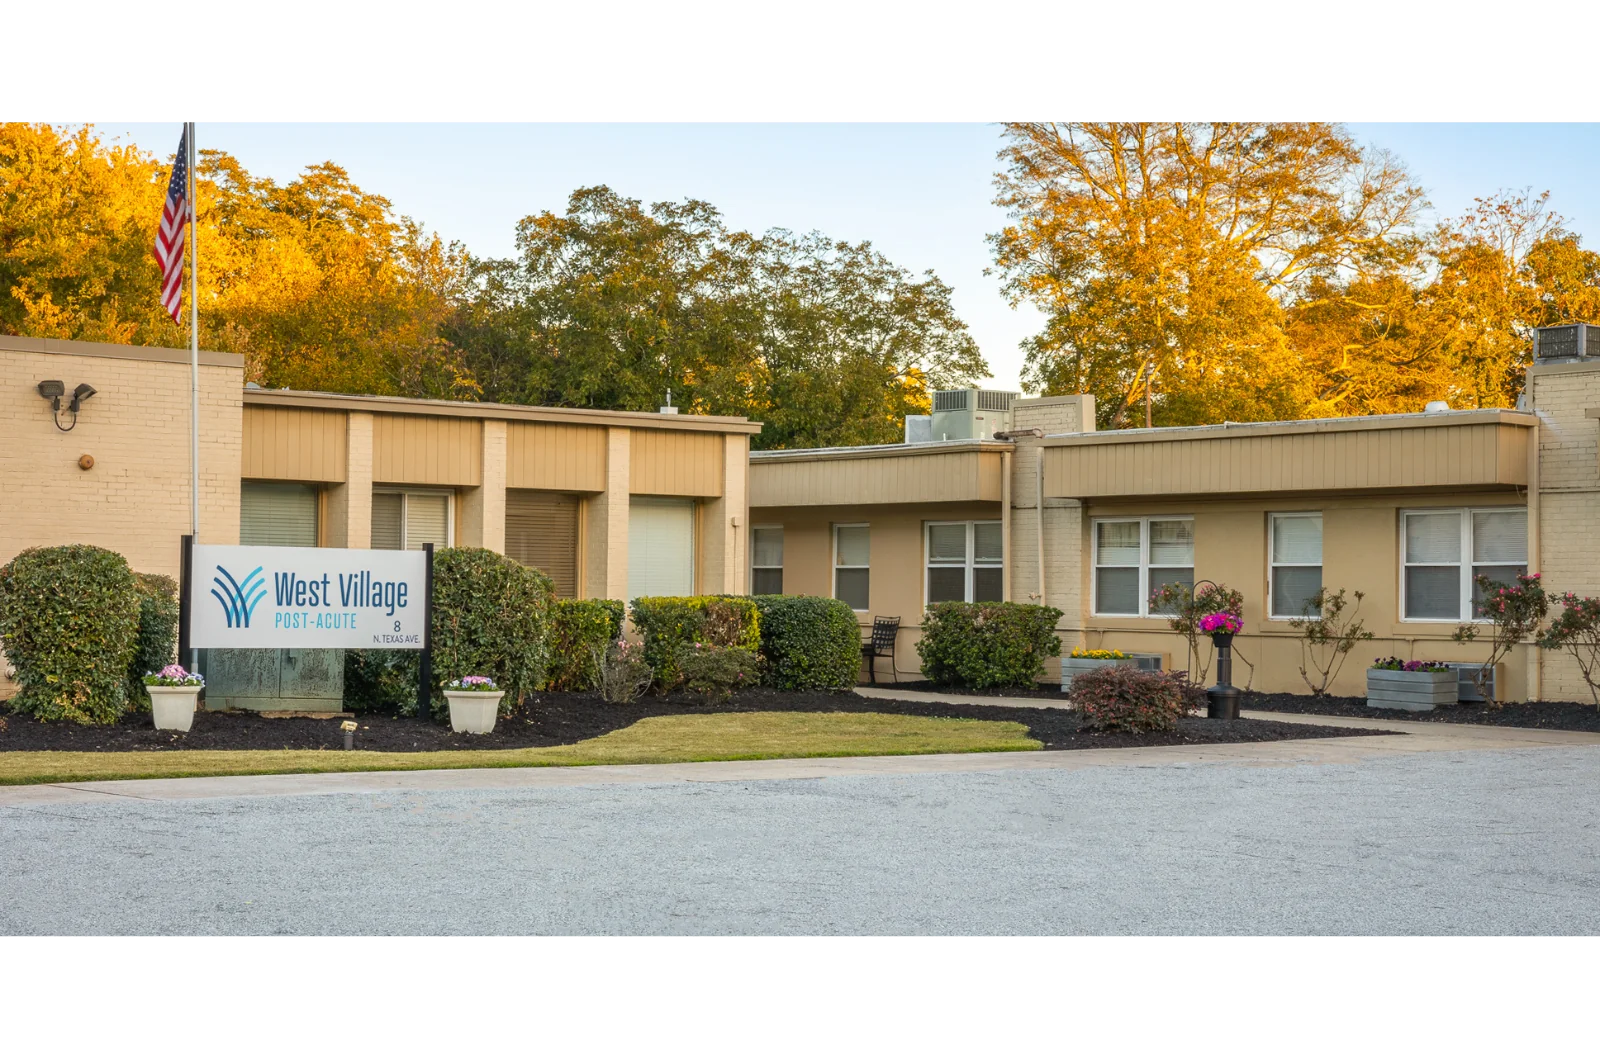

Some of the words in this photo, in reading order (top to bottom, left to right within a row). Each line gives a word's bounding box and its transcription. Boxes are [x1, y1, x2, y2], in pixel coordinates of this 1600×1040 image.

[274, 572, 331, 607] West
[338, 570, 408, 617] Village
[275, 612, 357, 629] POST-ACUTE
[393, 620, 401, 633] 8
[373, 634, 381, 644] N.
[382, 634, 404, 644] TEXAS
[404, 634, 421, 644] AVE.
